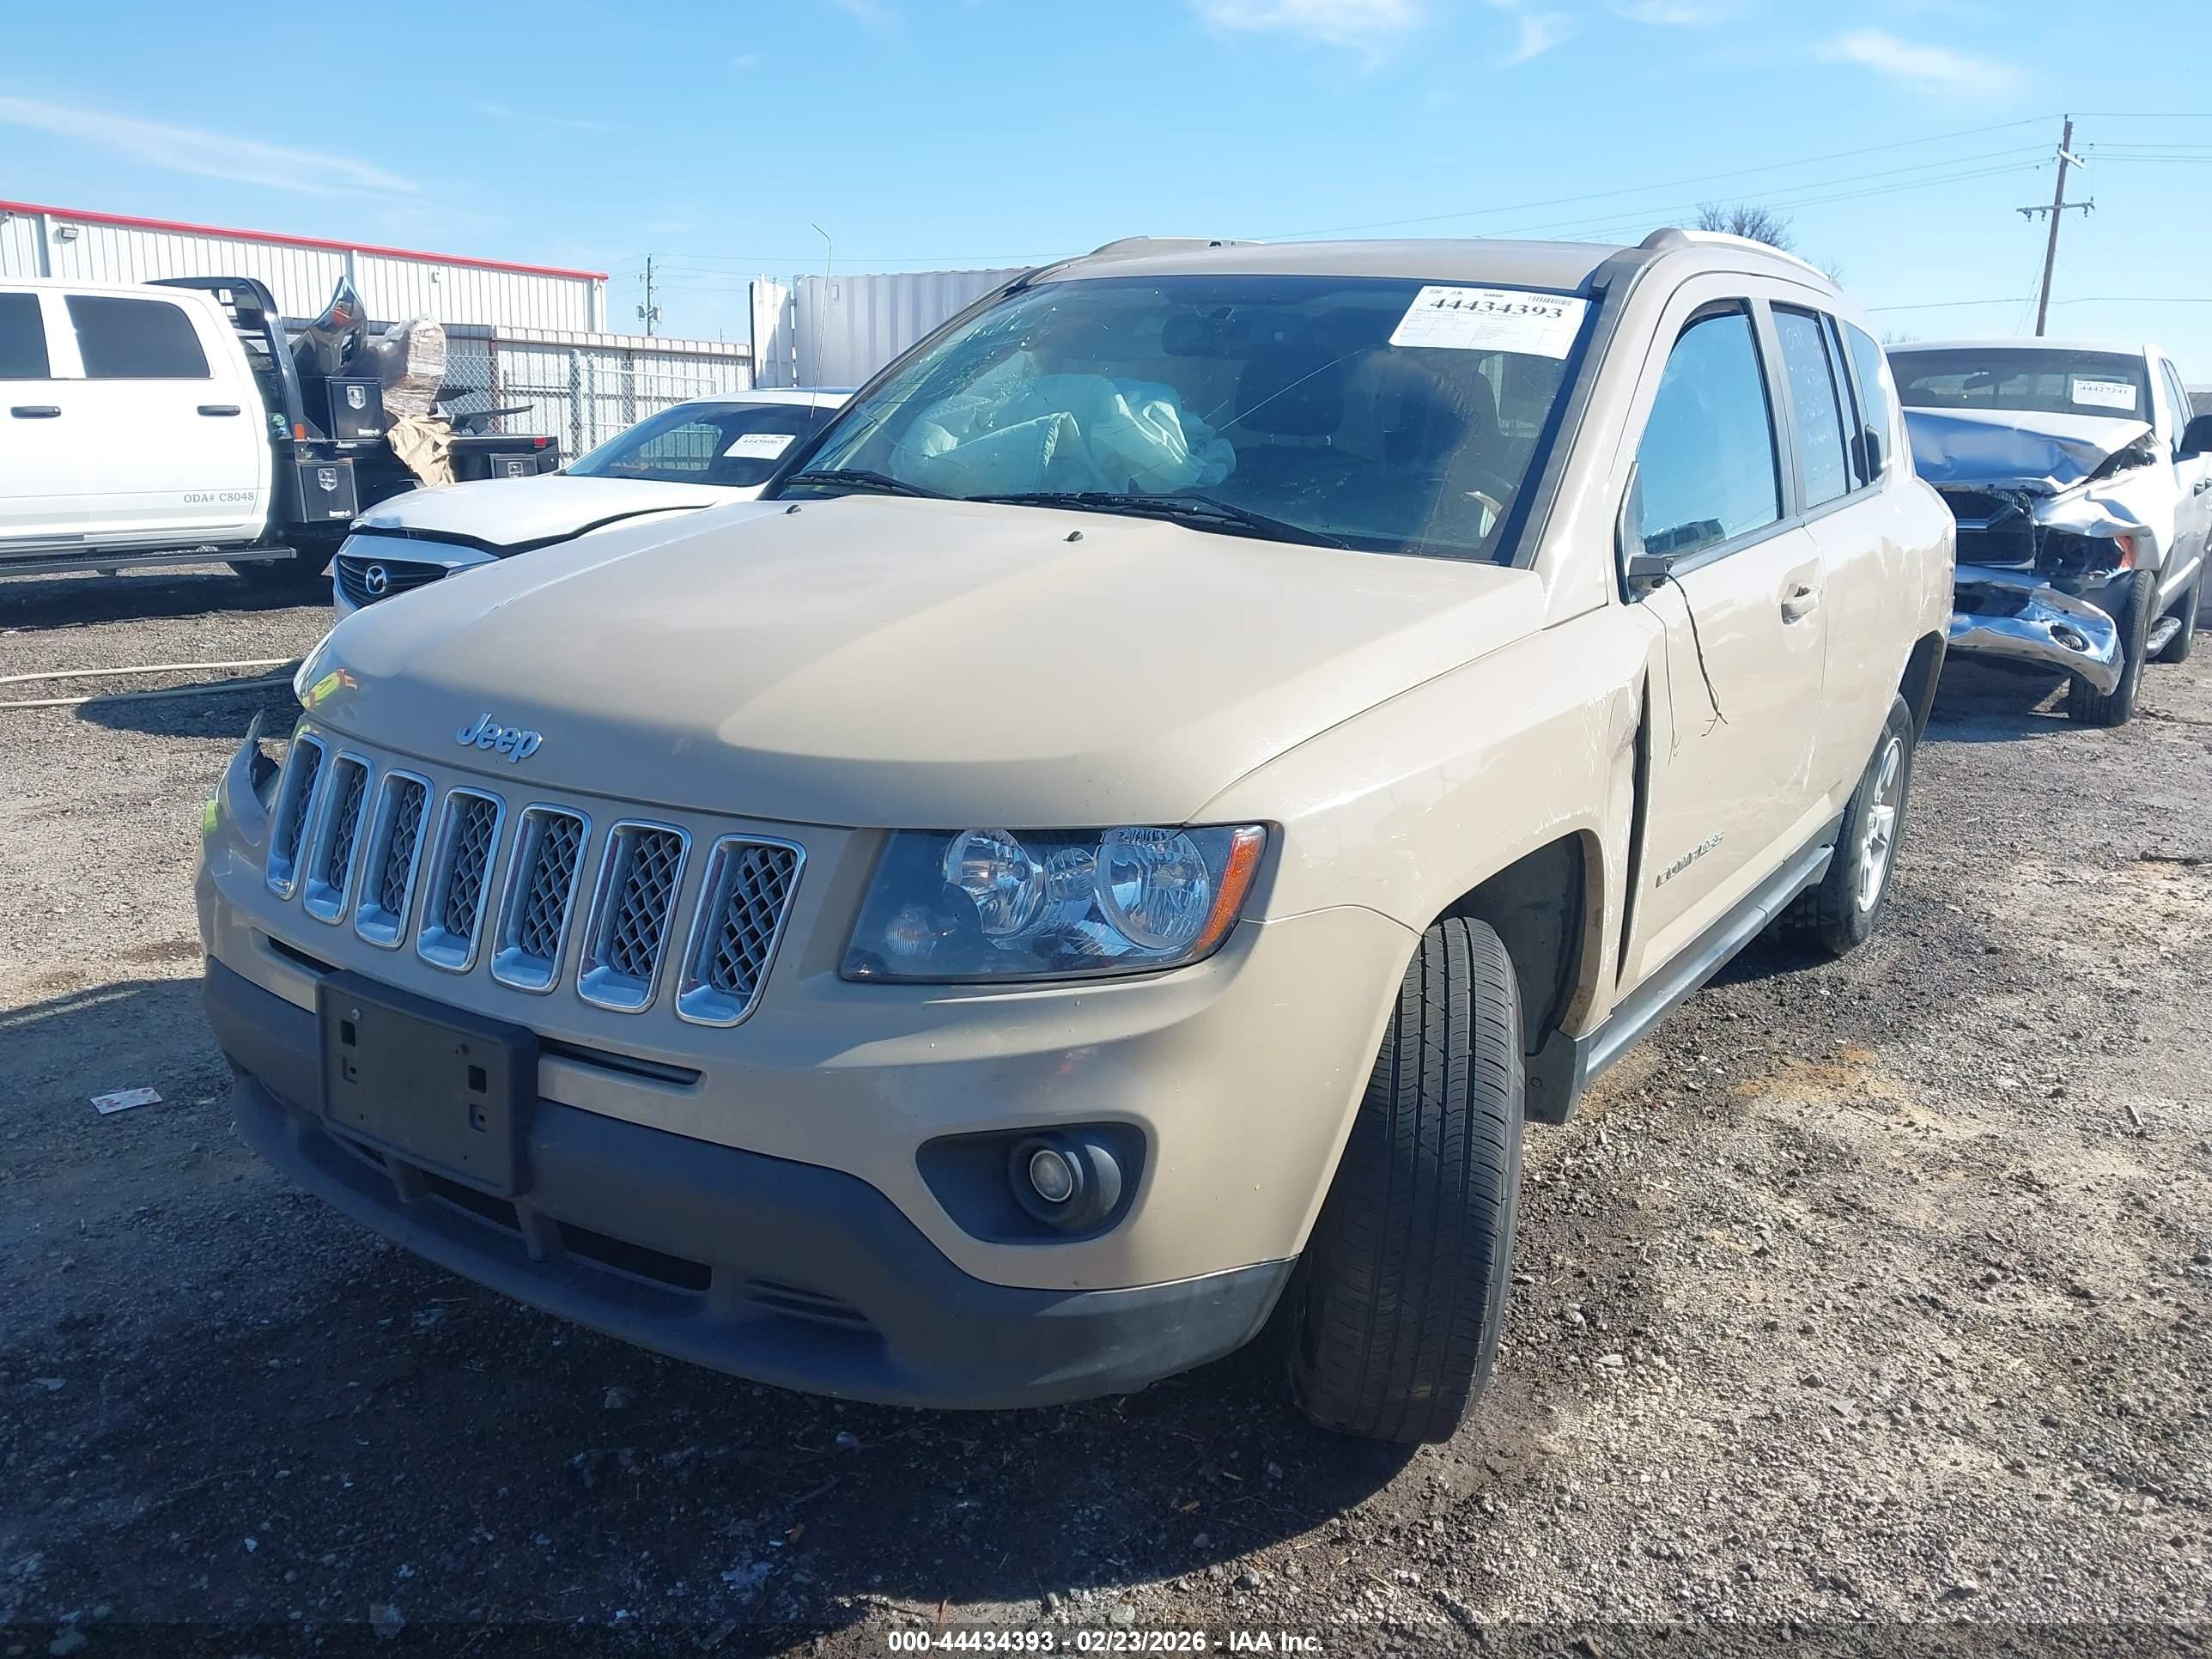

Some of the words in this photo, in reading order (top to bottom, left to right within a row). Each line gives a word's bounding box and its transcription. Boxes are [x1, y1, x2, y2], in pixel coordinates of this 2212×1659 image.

[1429, 298, 1563, 319] 44434393
[184, 494, 215, 503] ODA#
[219, 492, 255, 502] C8048
[456, 713, 544, 763] Jeep
